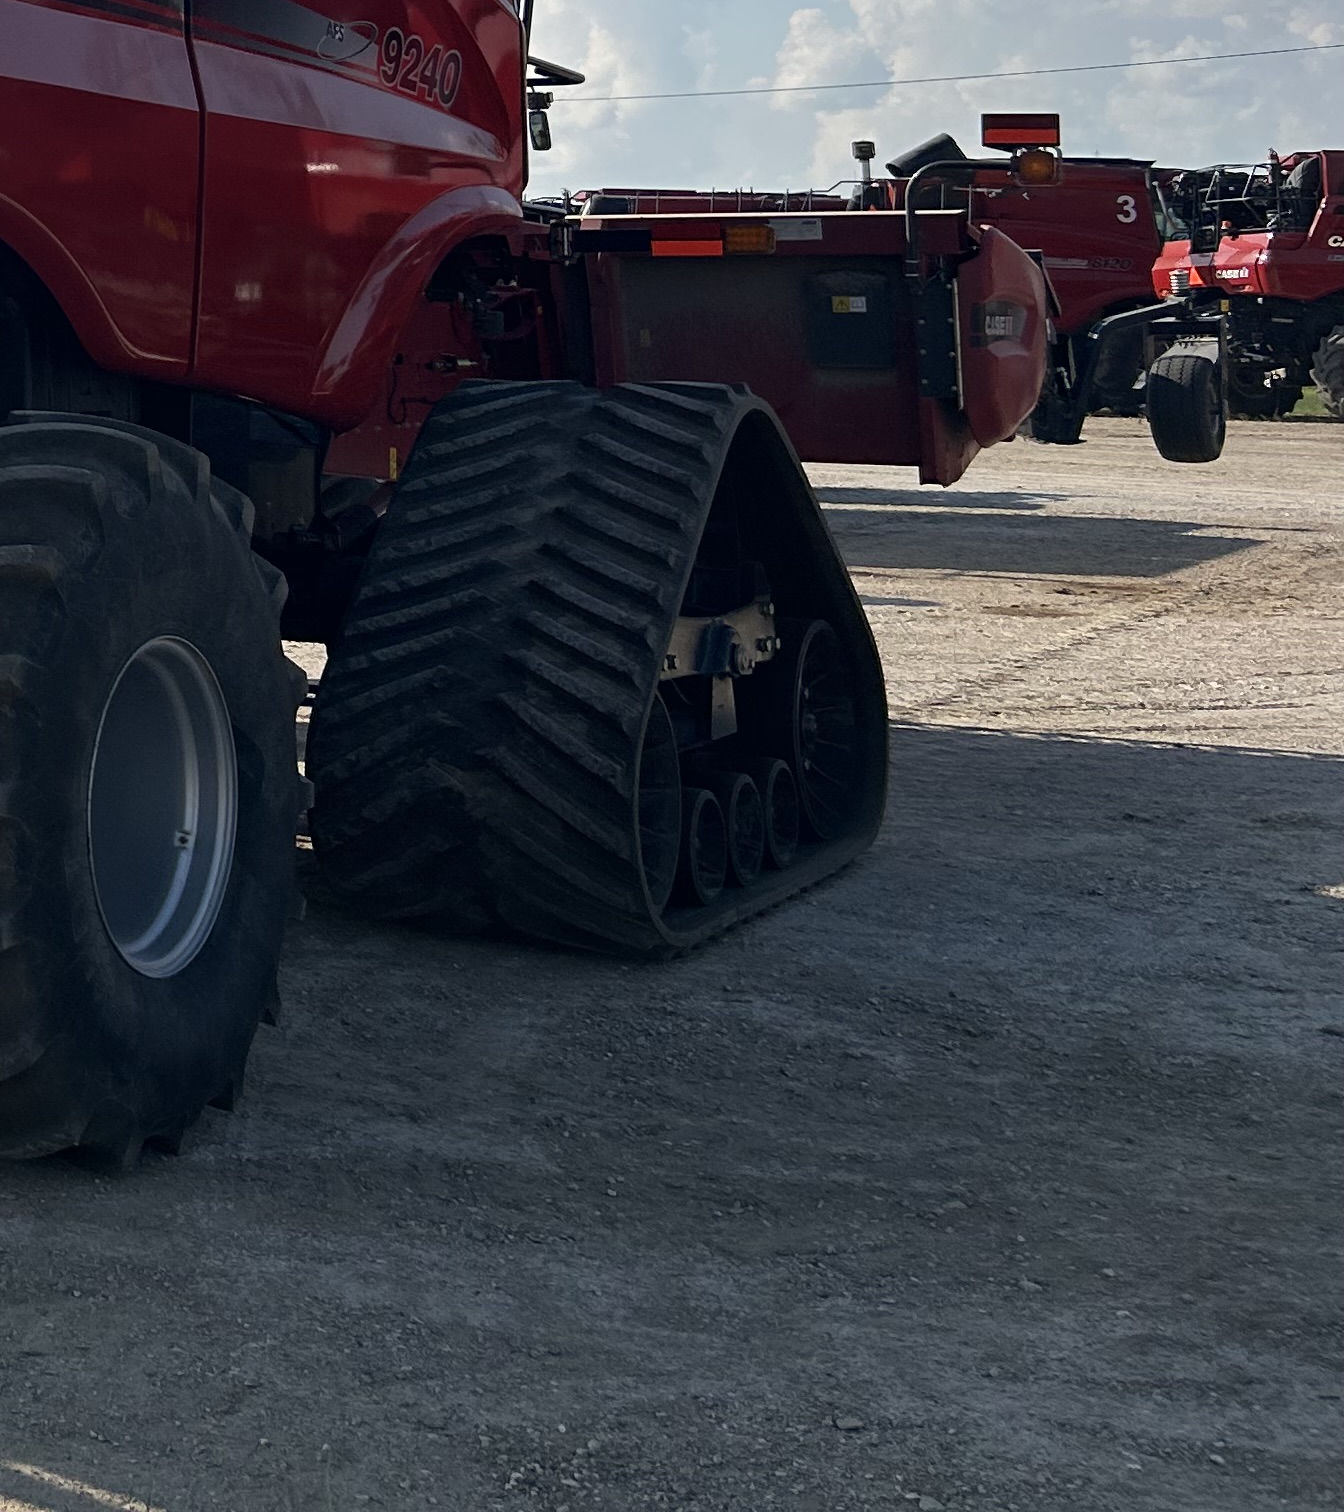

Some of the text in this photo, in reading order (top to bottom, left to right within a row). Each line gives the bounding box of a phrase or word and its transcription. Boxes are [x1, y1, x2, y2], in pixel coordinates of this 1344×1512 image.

[379, 26, 462, 107] 9240
[1116, 194, 1138, 224] 3
[1215, 269, 1240, 279] CASE
